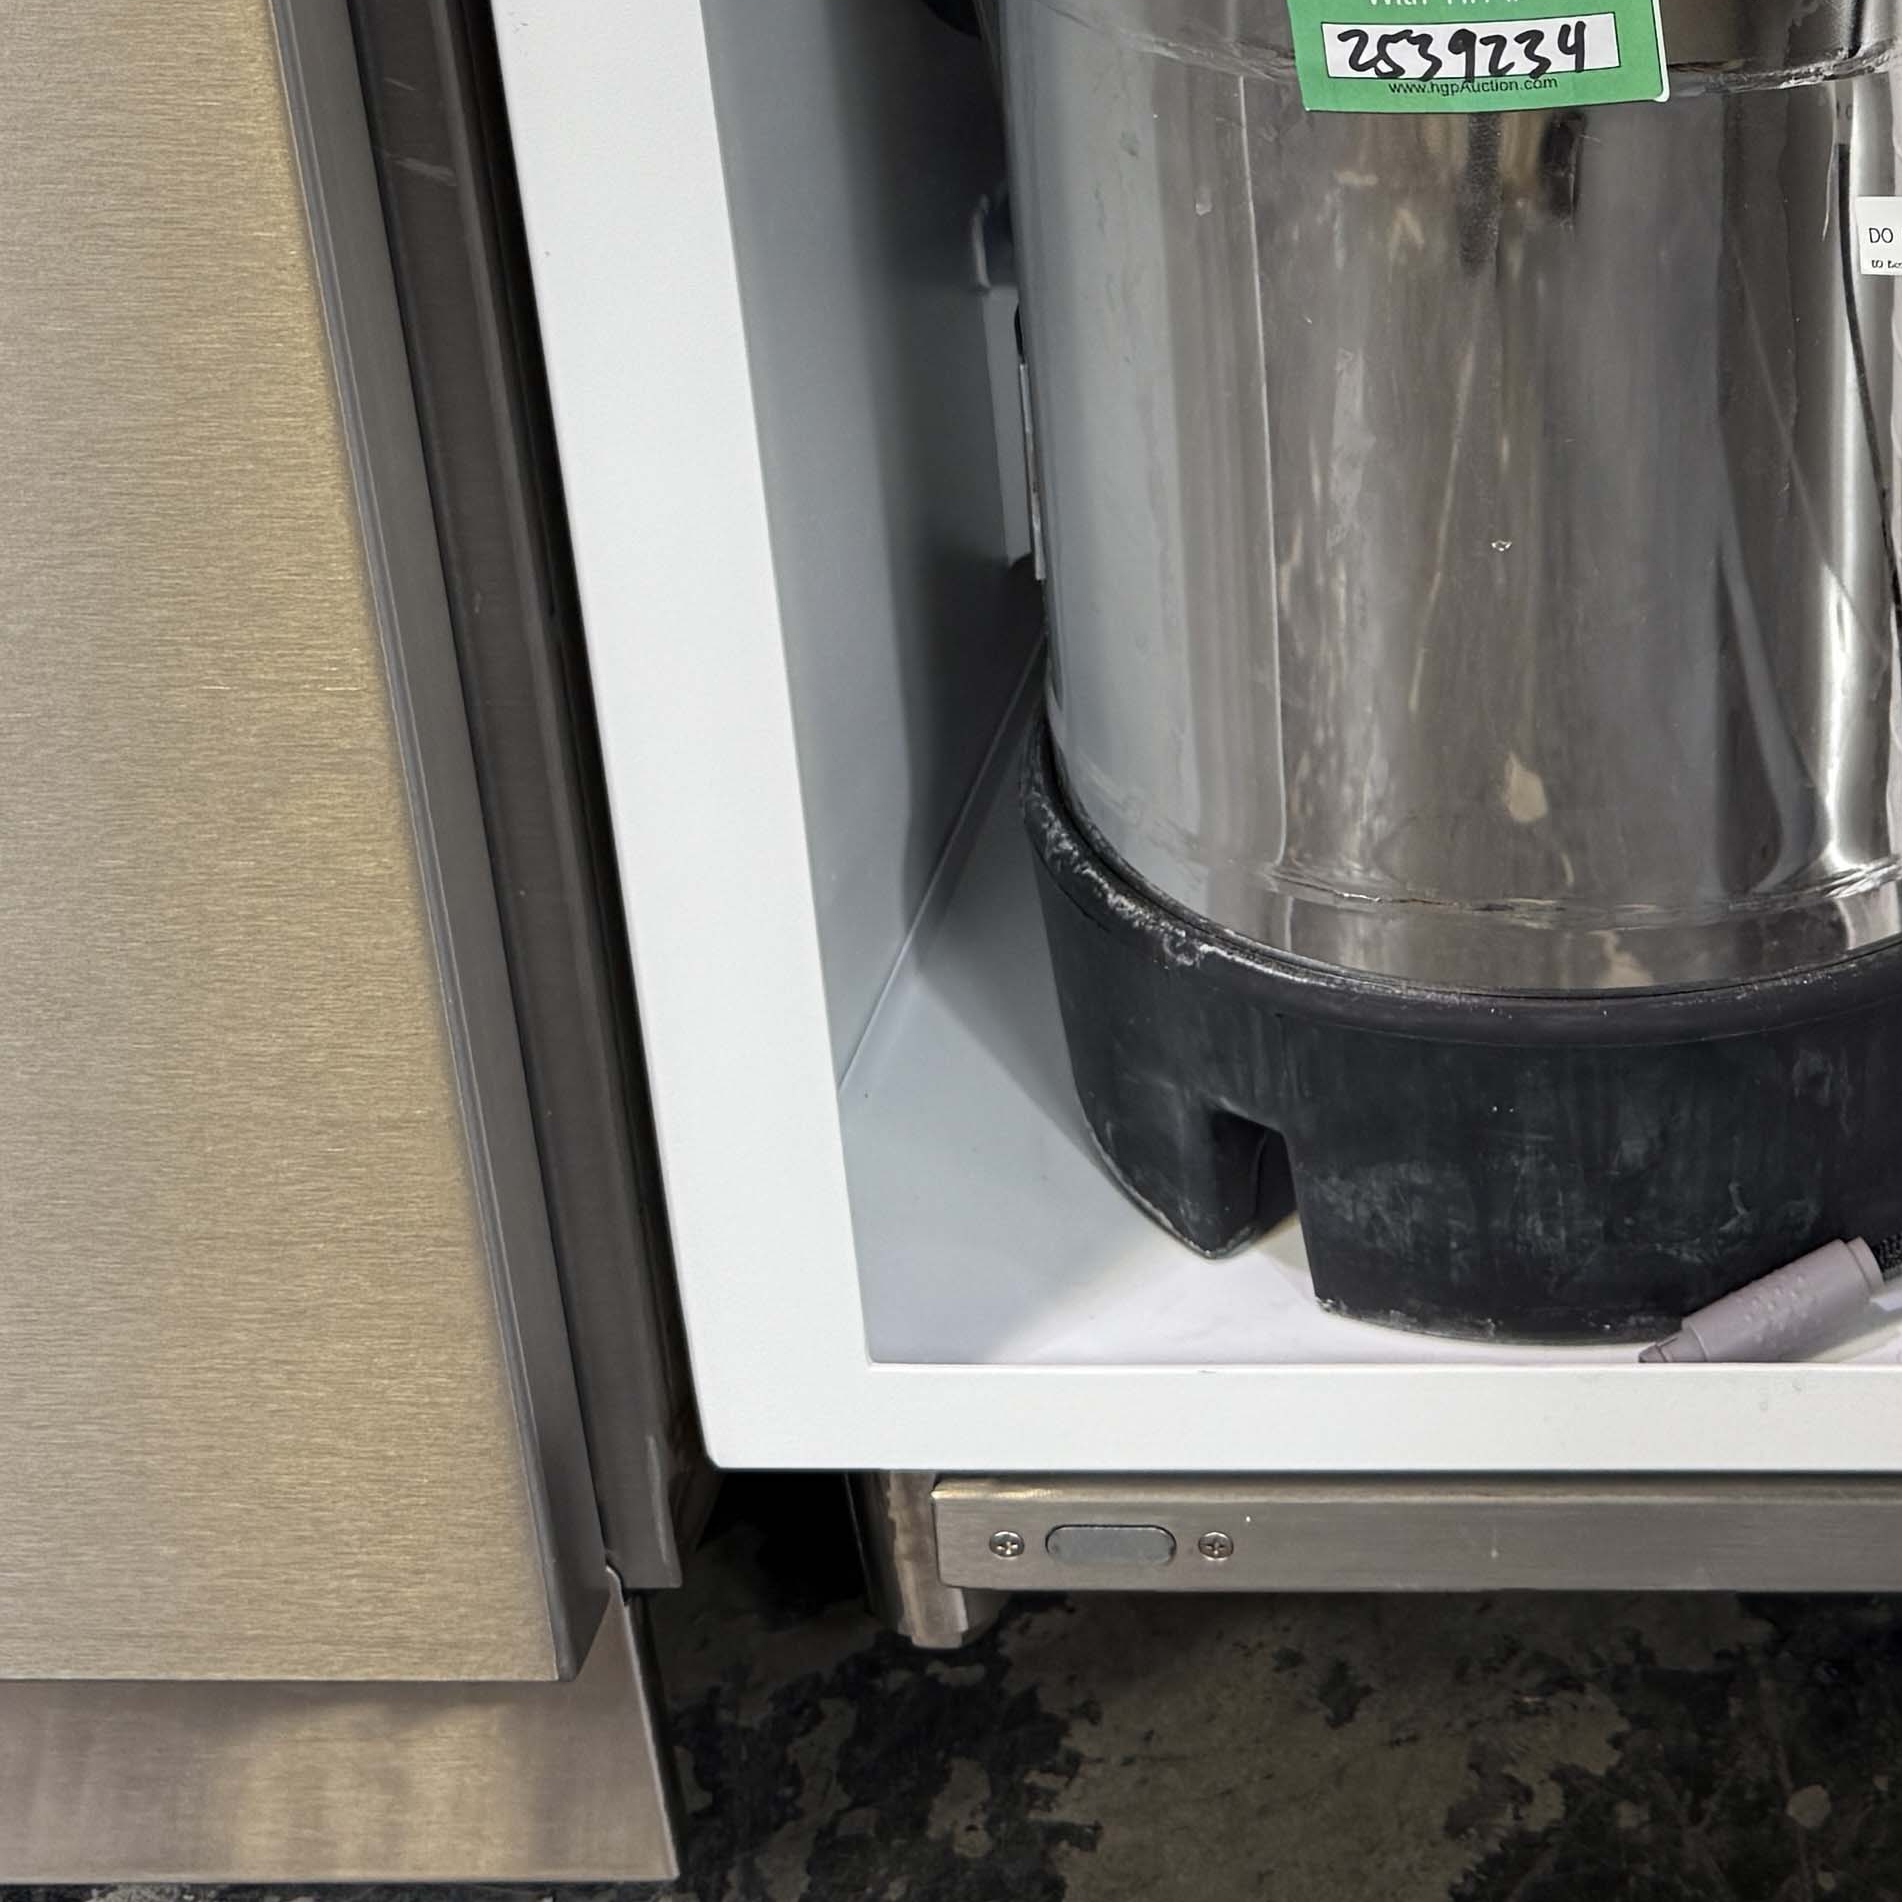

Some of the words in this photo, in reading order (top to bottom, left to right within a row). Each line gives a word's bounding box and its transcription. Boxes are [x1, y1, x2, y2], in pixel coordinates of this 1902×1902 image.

[1337, 21, 1586, 82] 2539234
[1388, 76, 1558, 96] www.hgpAuction.com
[1868, 228, 1894, 244] DO
